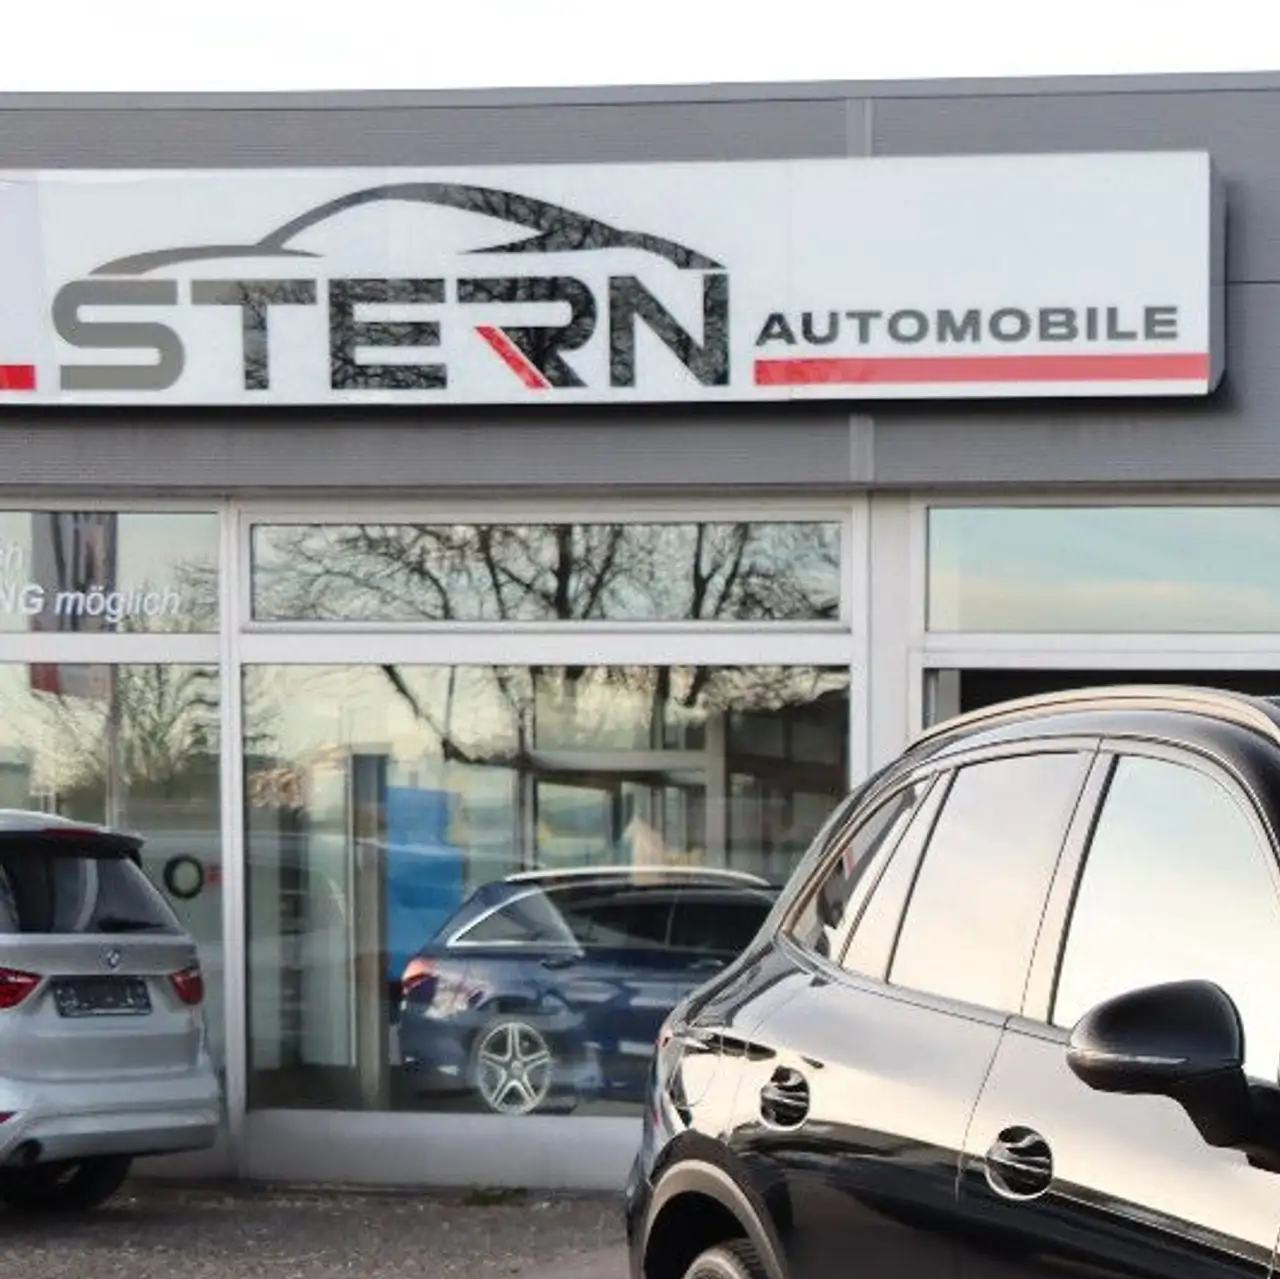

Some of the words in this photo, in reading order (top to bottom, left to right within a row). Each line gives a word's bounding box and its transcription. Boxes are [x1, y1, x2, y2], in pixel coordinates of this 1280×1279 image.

[51, 275, 730, 391] STERN
[755, 306, 1179, 346] AUTOMOBILE
[54, 585, 180, 622] möglich
